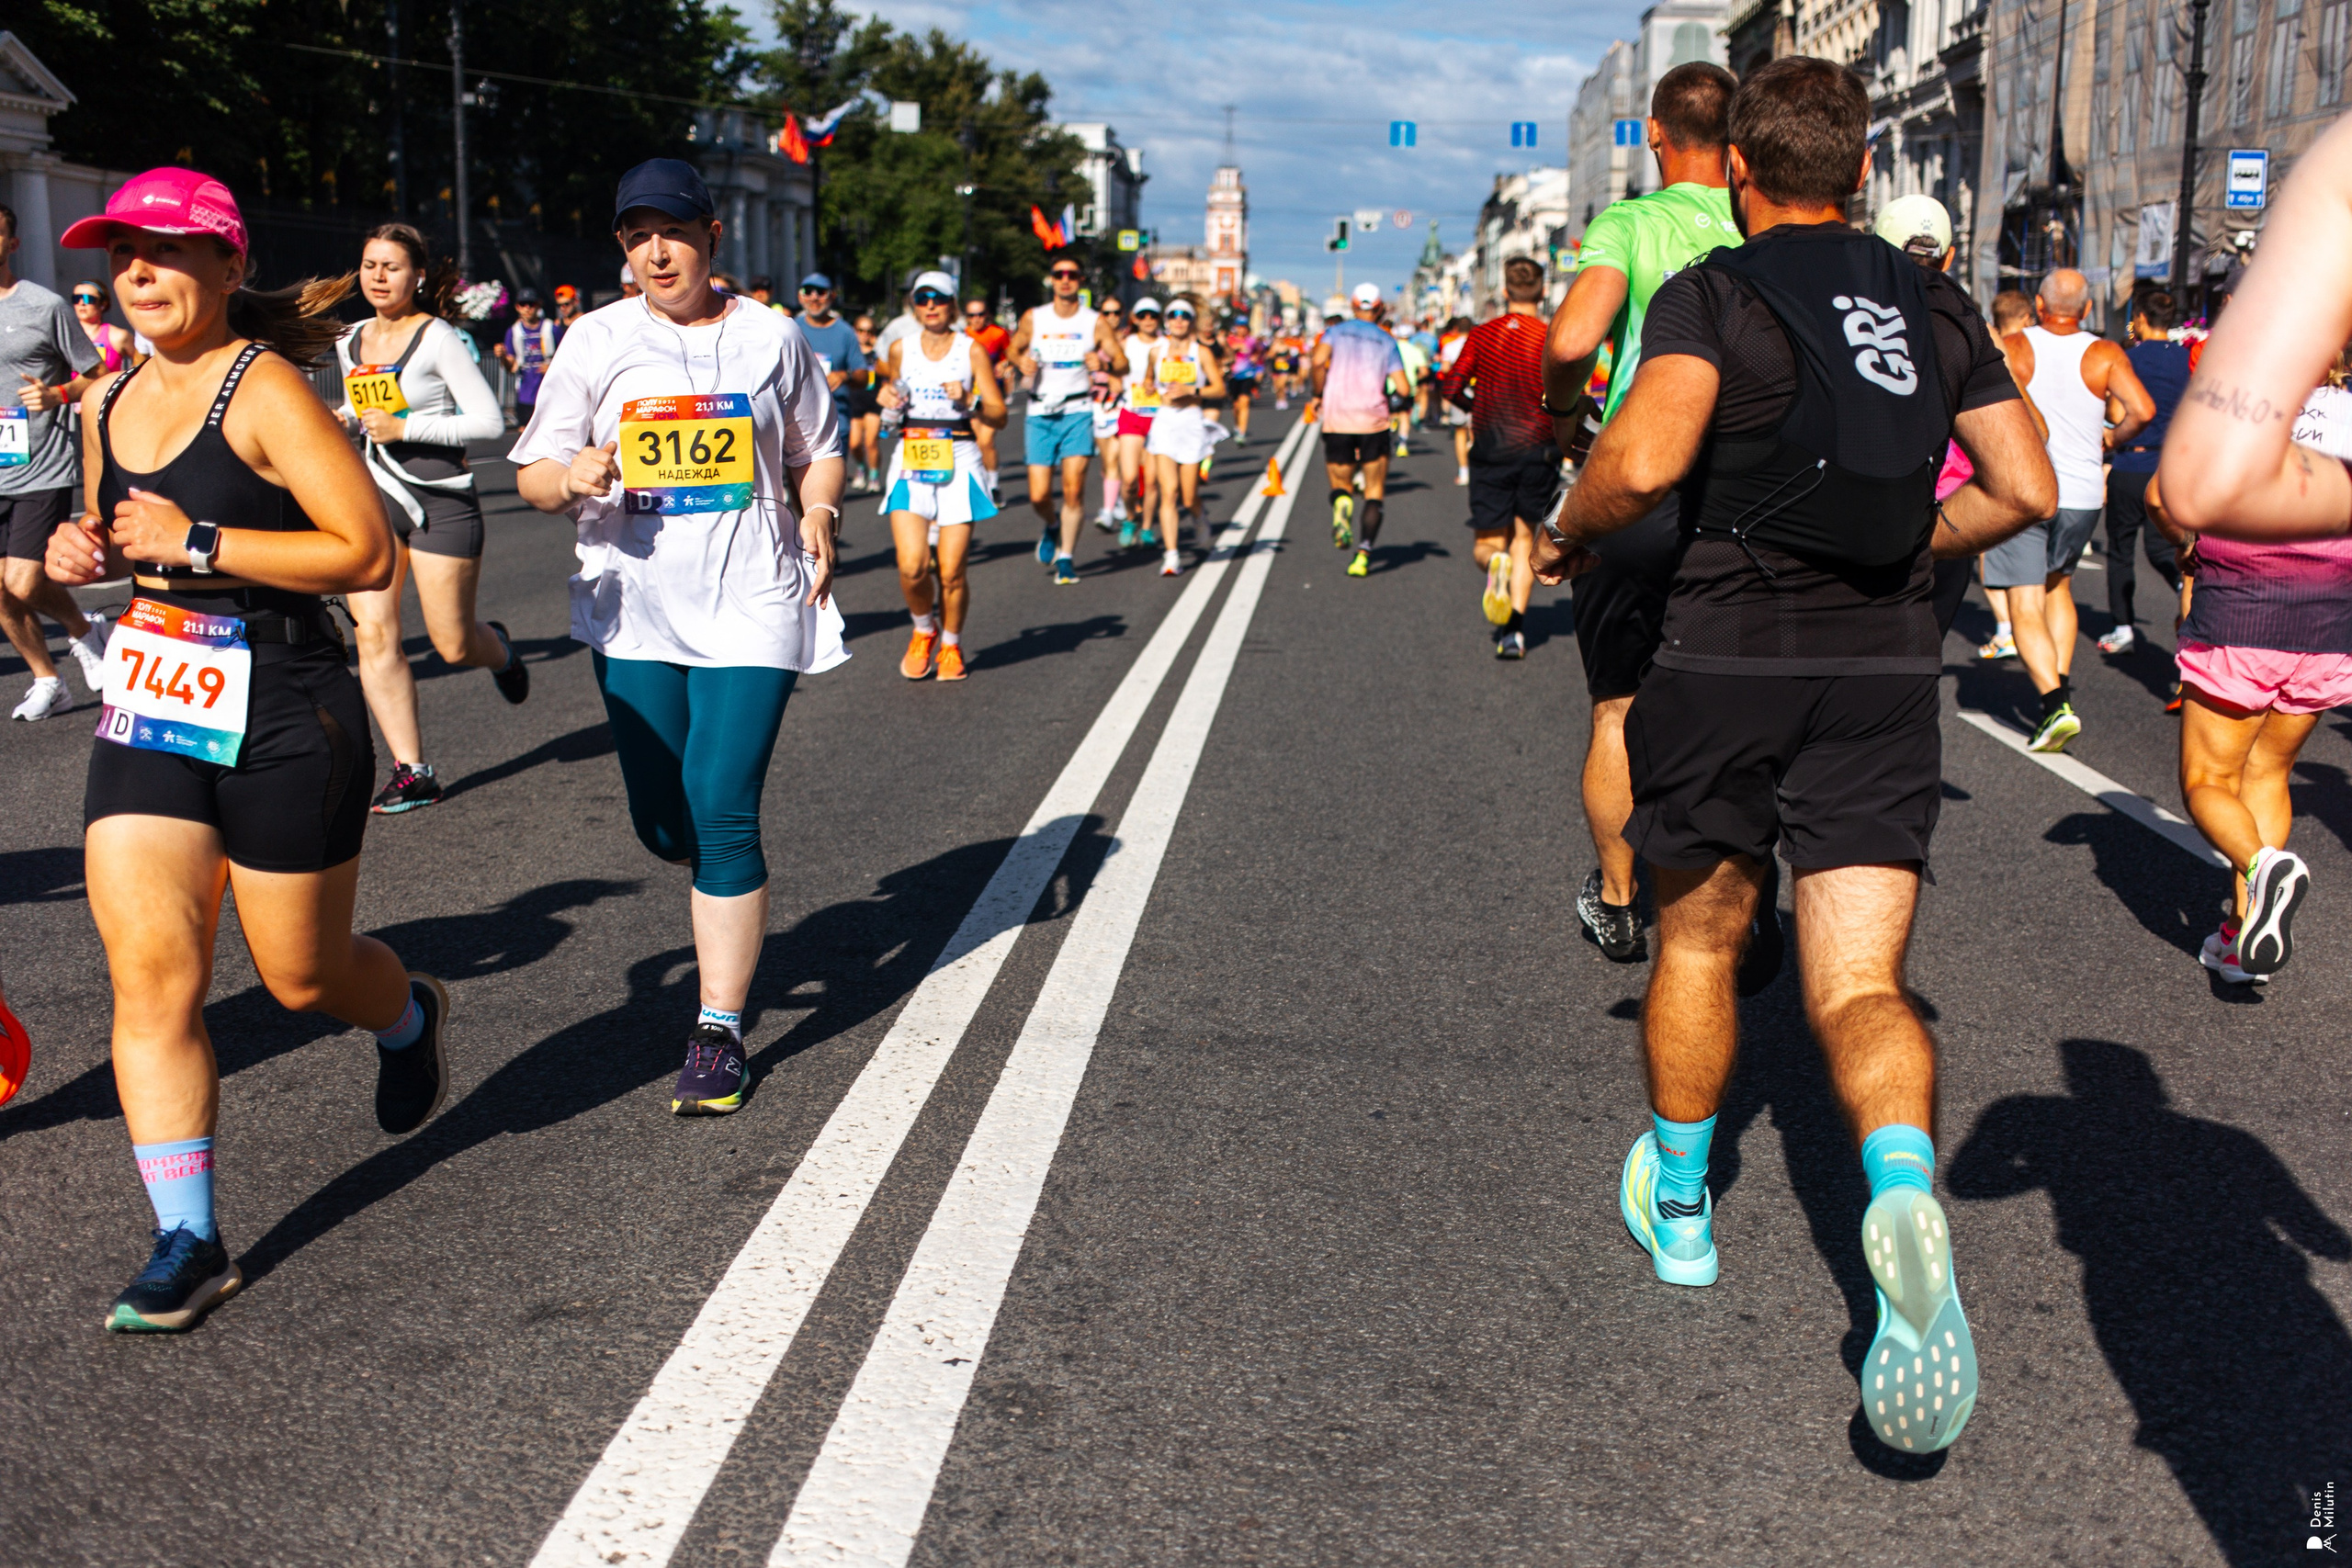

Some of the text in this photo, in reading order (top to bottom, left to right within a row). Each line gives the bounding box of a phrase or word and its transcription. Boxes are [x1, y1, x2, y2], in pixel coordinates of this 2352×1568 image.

[221, 349, 256, 397] ARMOUR
[352, 379, 393, 405] 5112
[636, 405, 677, 414] МАРАФОН
[638, 428, 736, 466] 3162
[911, 445, 940, 460] 185
[658, 468, 721, 481] НАДЕЖДА
[637, 491, 653, 511] D
[131, 610, 165, 626] МАРАФОН
[121, 647, 225, 709] 7449
[114, 712, 130, 736] D
